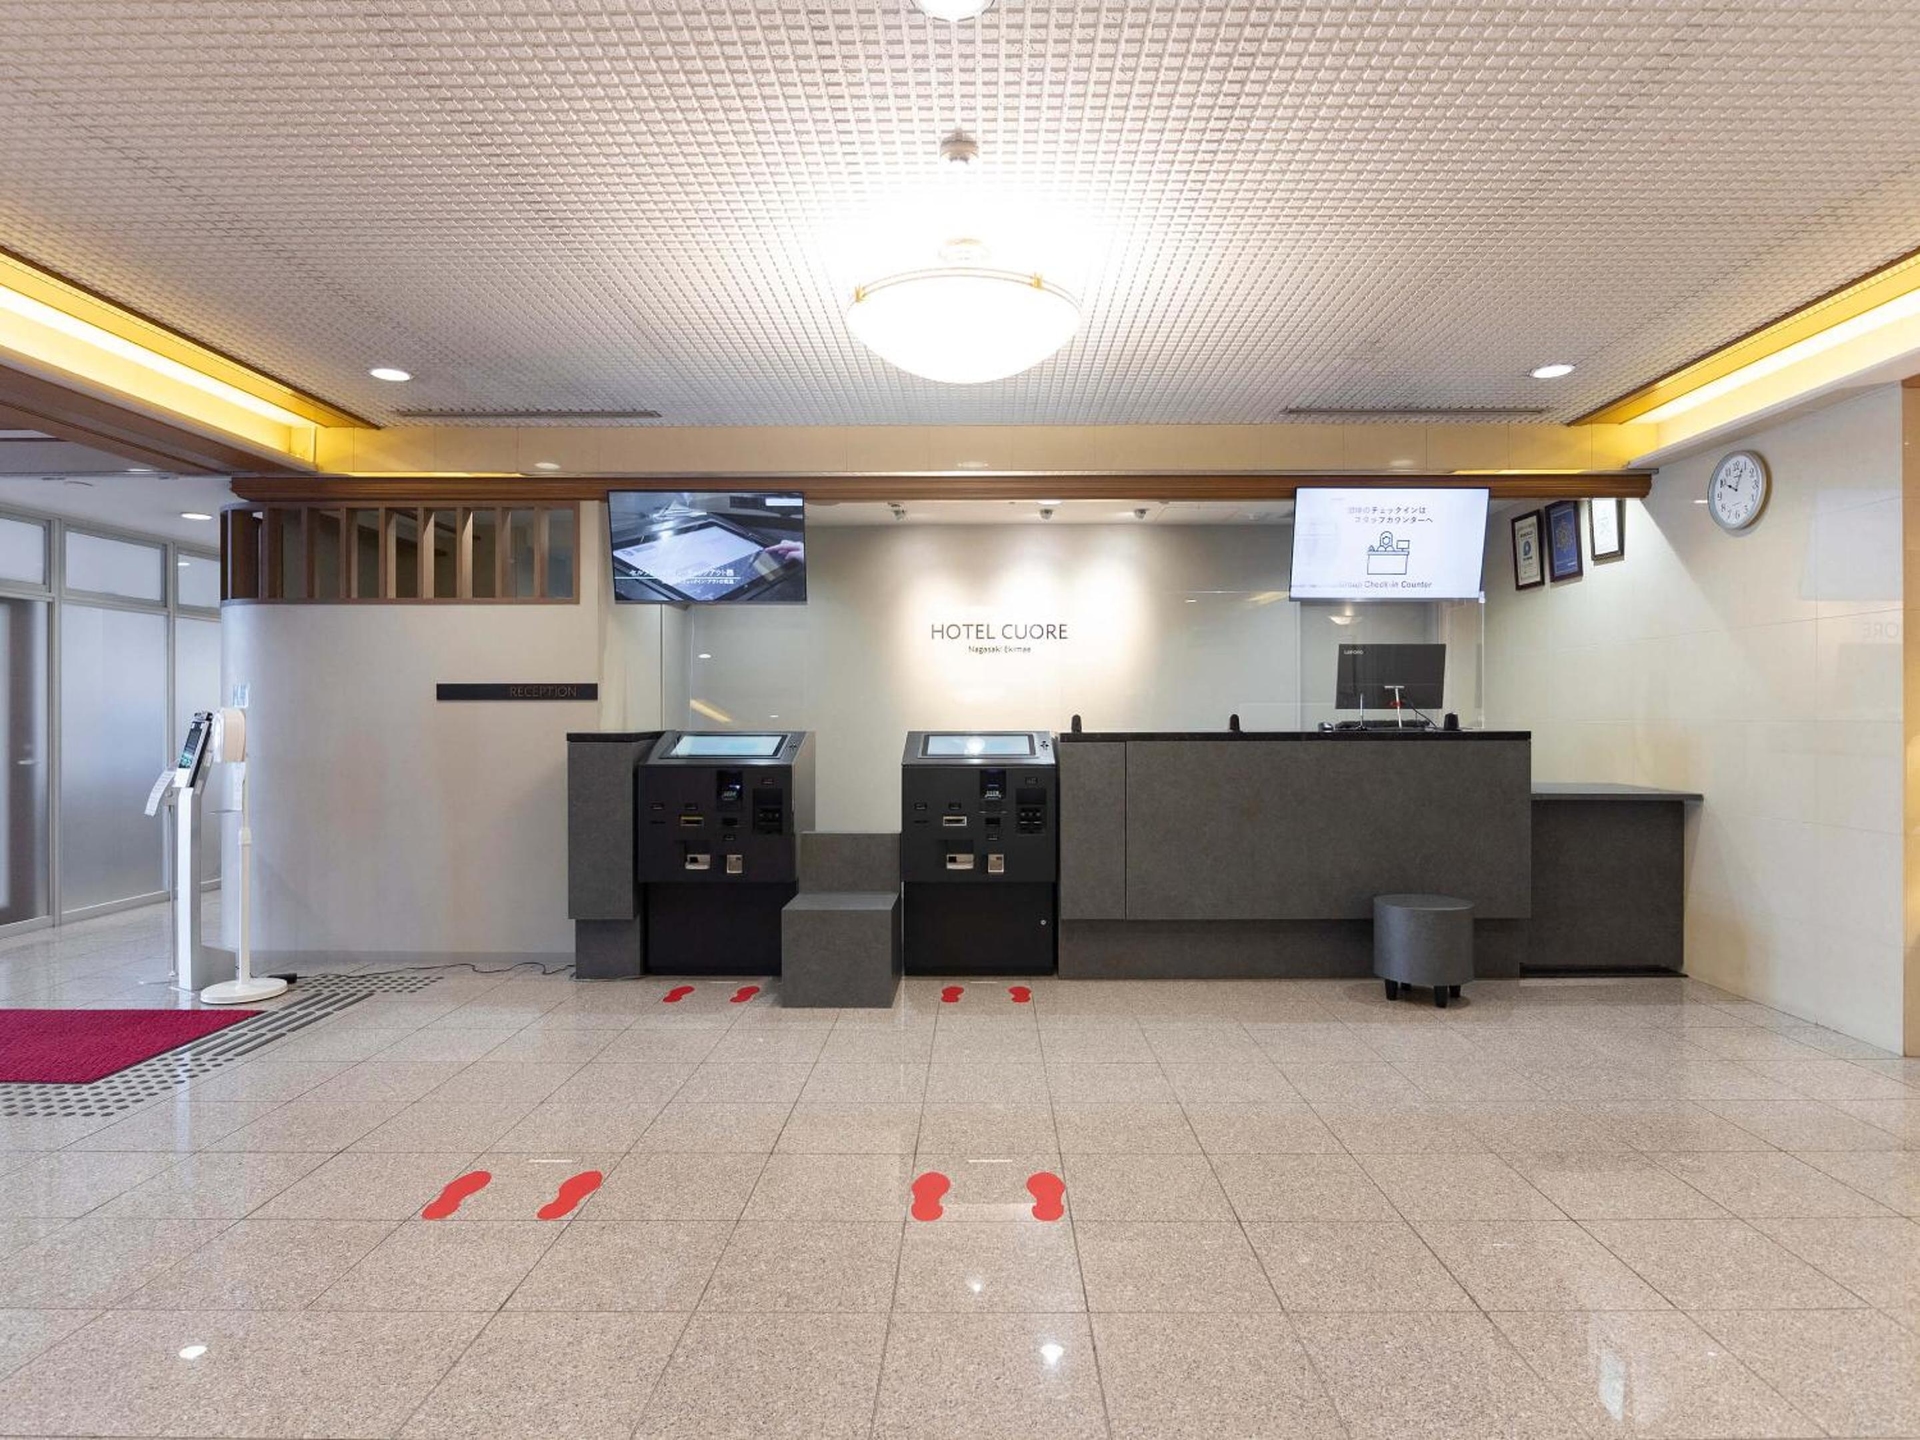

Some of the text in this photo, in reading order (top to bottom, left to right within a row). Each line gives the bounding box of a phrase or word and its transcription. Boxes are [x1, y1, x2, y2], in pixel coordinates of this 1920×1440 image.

[1401, 580, 1433, 589] Counter
[931, 623, 1069, 640] HOTEL CUORE
[968, 645, 1002, 655] Nagasaki
[509, 686, 577, 698] RECEPTION
